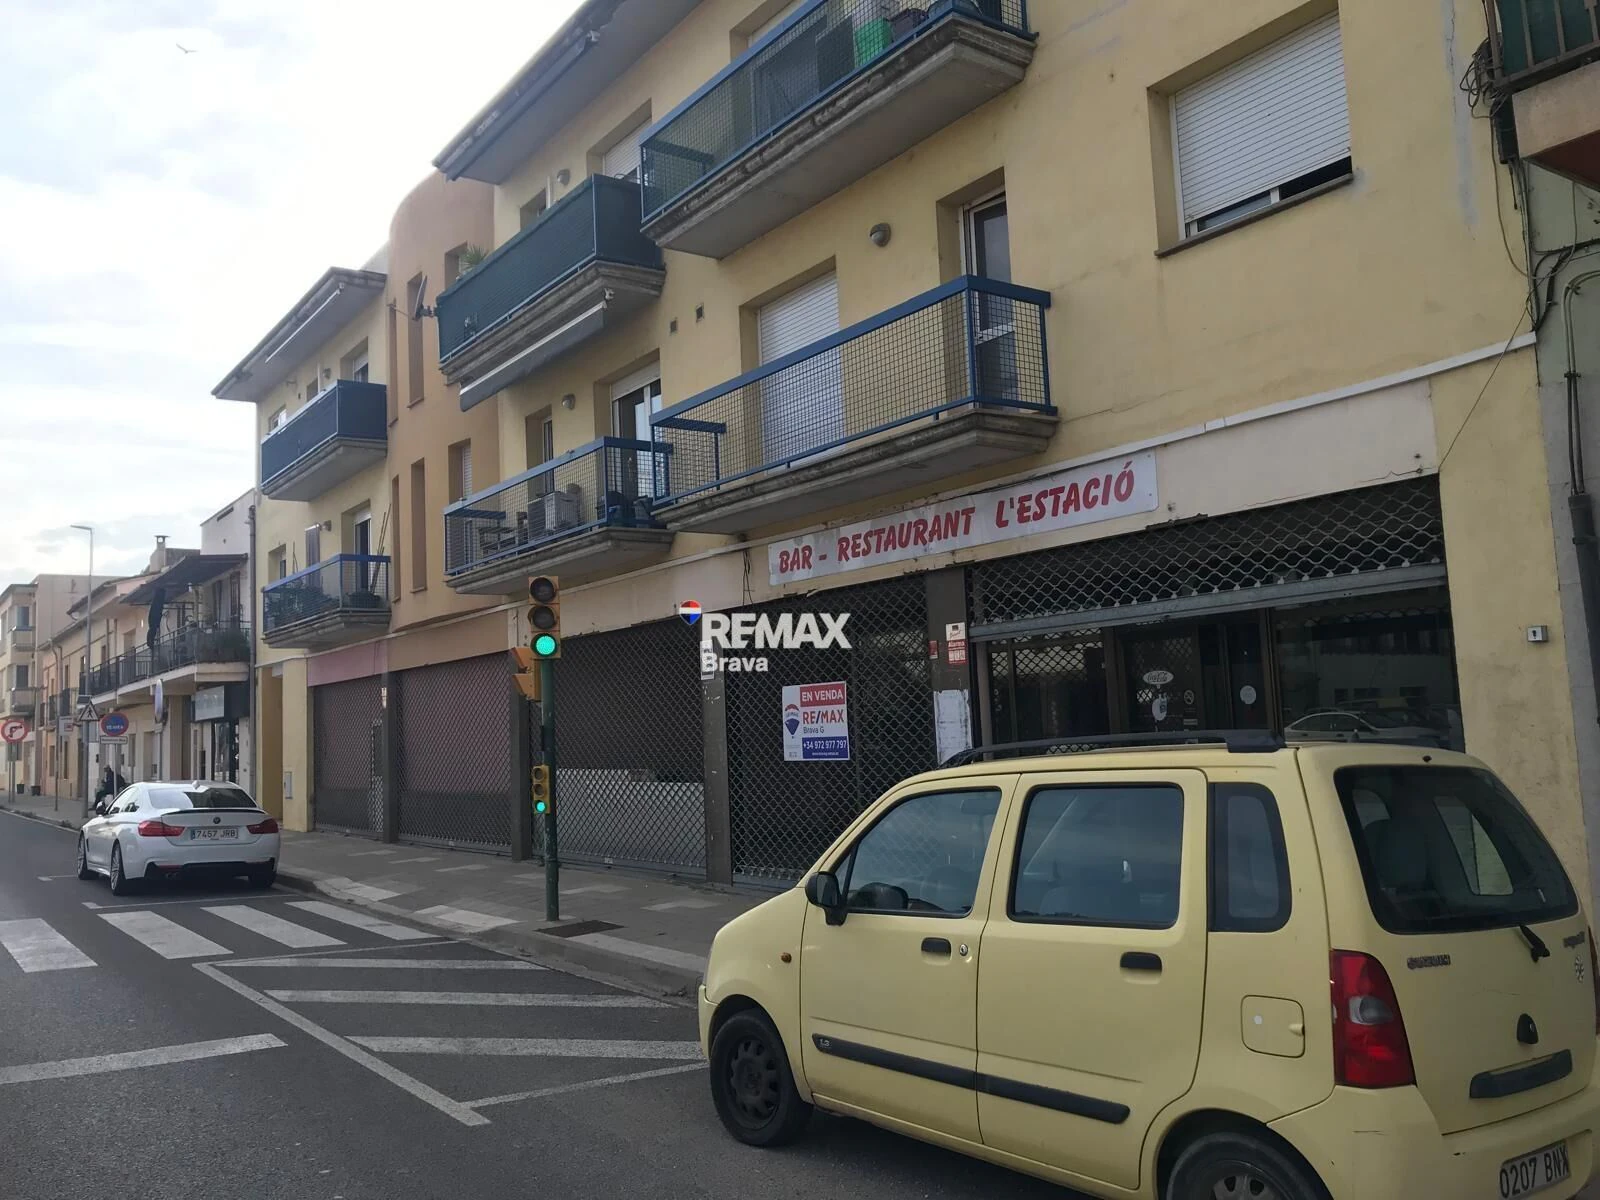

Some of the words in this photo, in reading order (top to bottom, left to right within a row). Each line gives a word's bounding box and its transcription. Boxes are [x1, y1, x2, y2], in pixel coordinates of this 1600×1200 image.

[778, 544, 813, 574] BAR
[837, 507, 976, 562] RESTAURANT
[995, 461, 1136, 529] L'ESTACIÓ
[802, 691, 812, 702] EN
[814, 690, 843, 701] VENDA
[803, 710, 844, 724] RE/MAX
[803, 726, 819, 734] Brava
[803, 740, 814, 749] +34
[814, 740, 825, 749] 972
[825, 740, 836, 749] 977
[836, 740, 847, 749] 797
[1500, 1157, 1537, 1198] 0207
[1543, 1143, 1569, 1183] BNX
